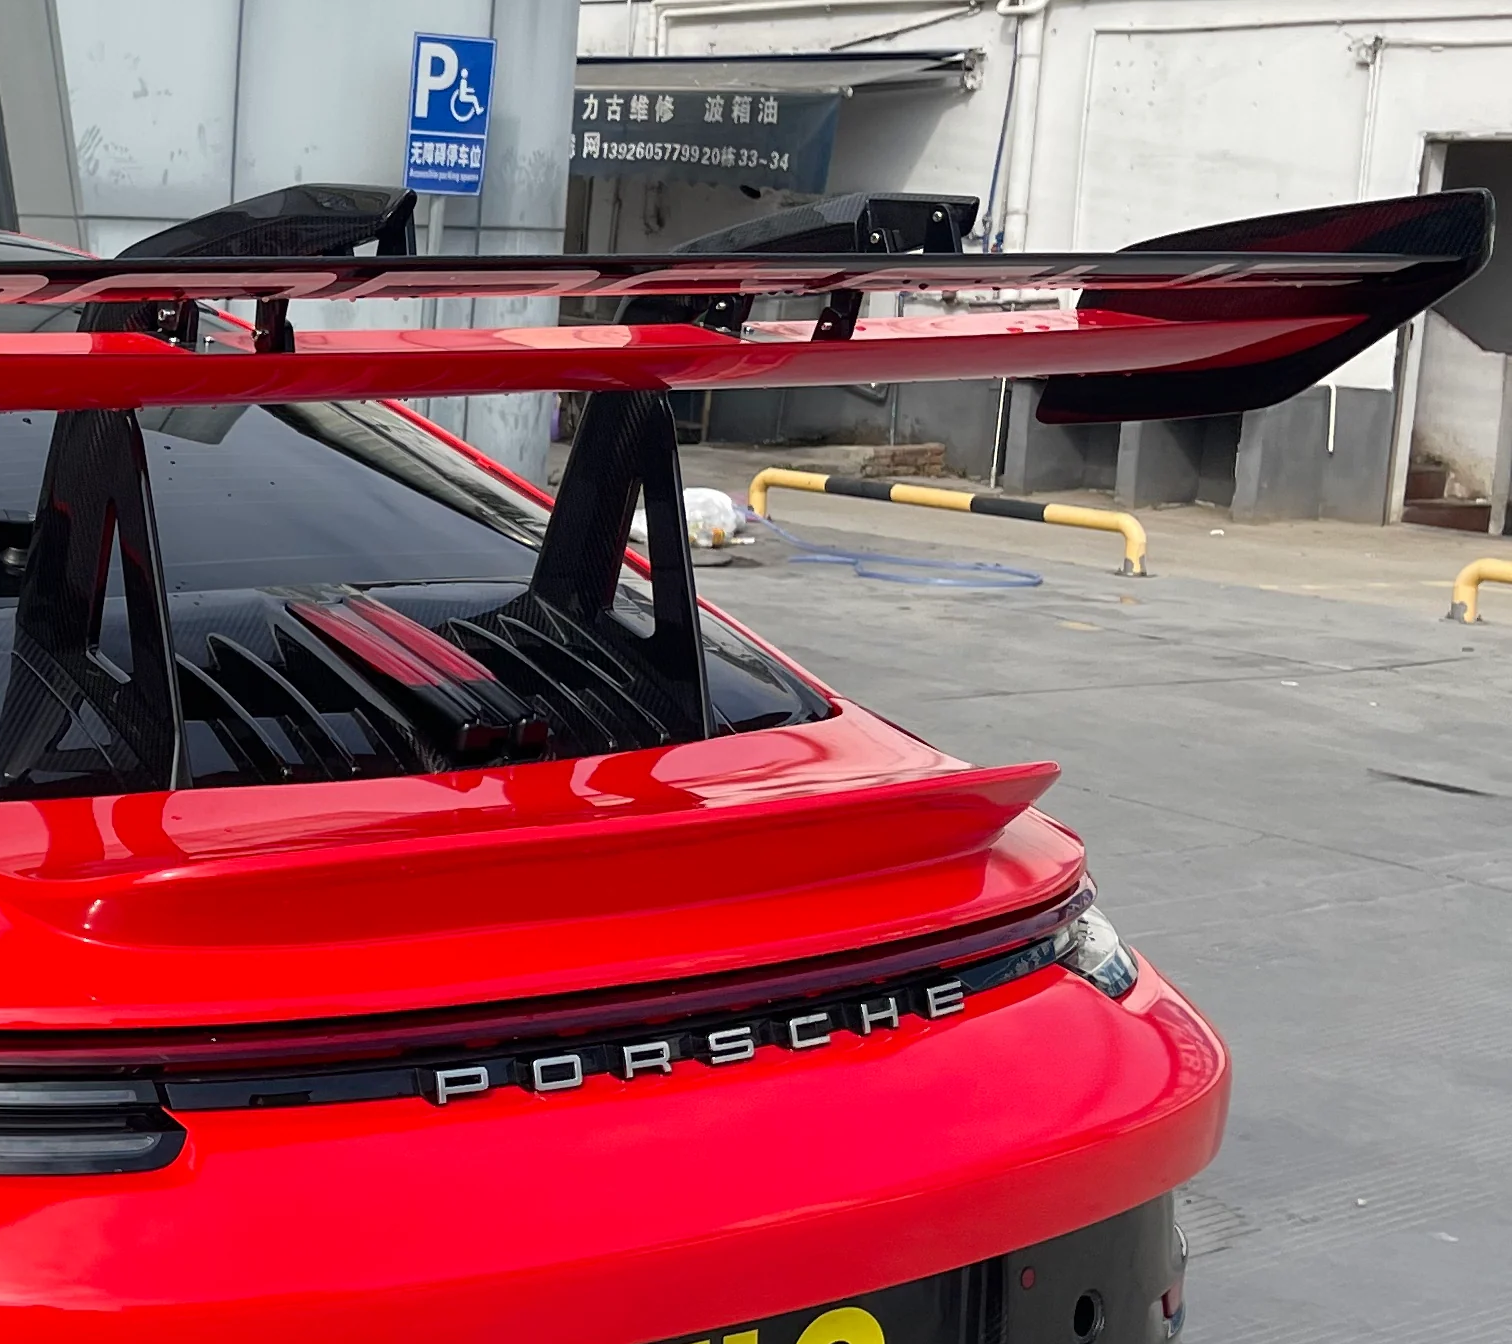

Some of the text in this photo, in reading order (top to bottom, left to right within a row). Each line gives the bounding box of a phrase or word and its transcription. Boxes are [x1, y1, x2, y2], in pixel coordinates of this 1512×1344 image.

[414, 41, 459, 118] P
[410, 141, 481, 168] 无障碍停车位
[436, 979, 965, 1105] PORSCHE
